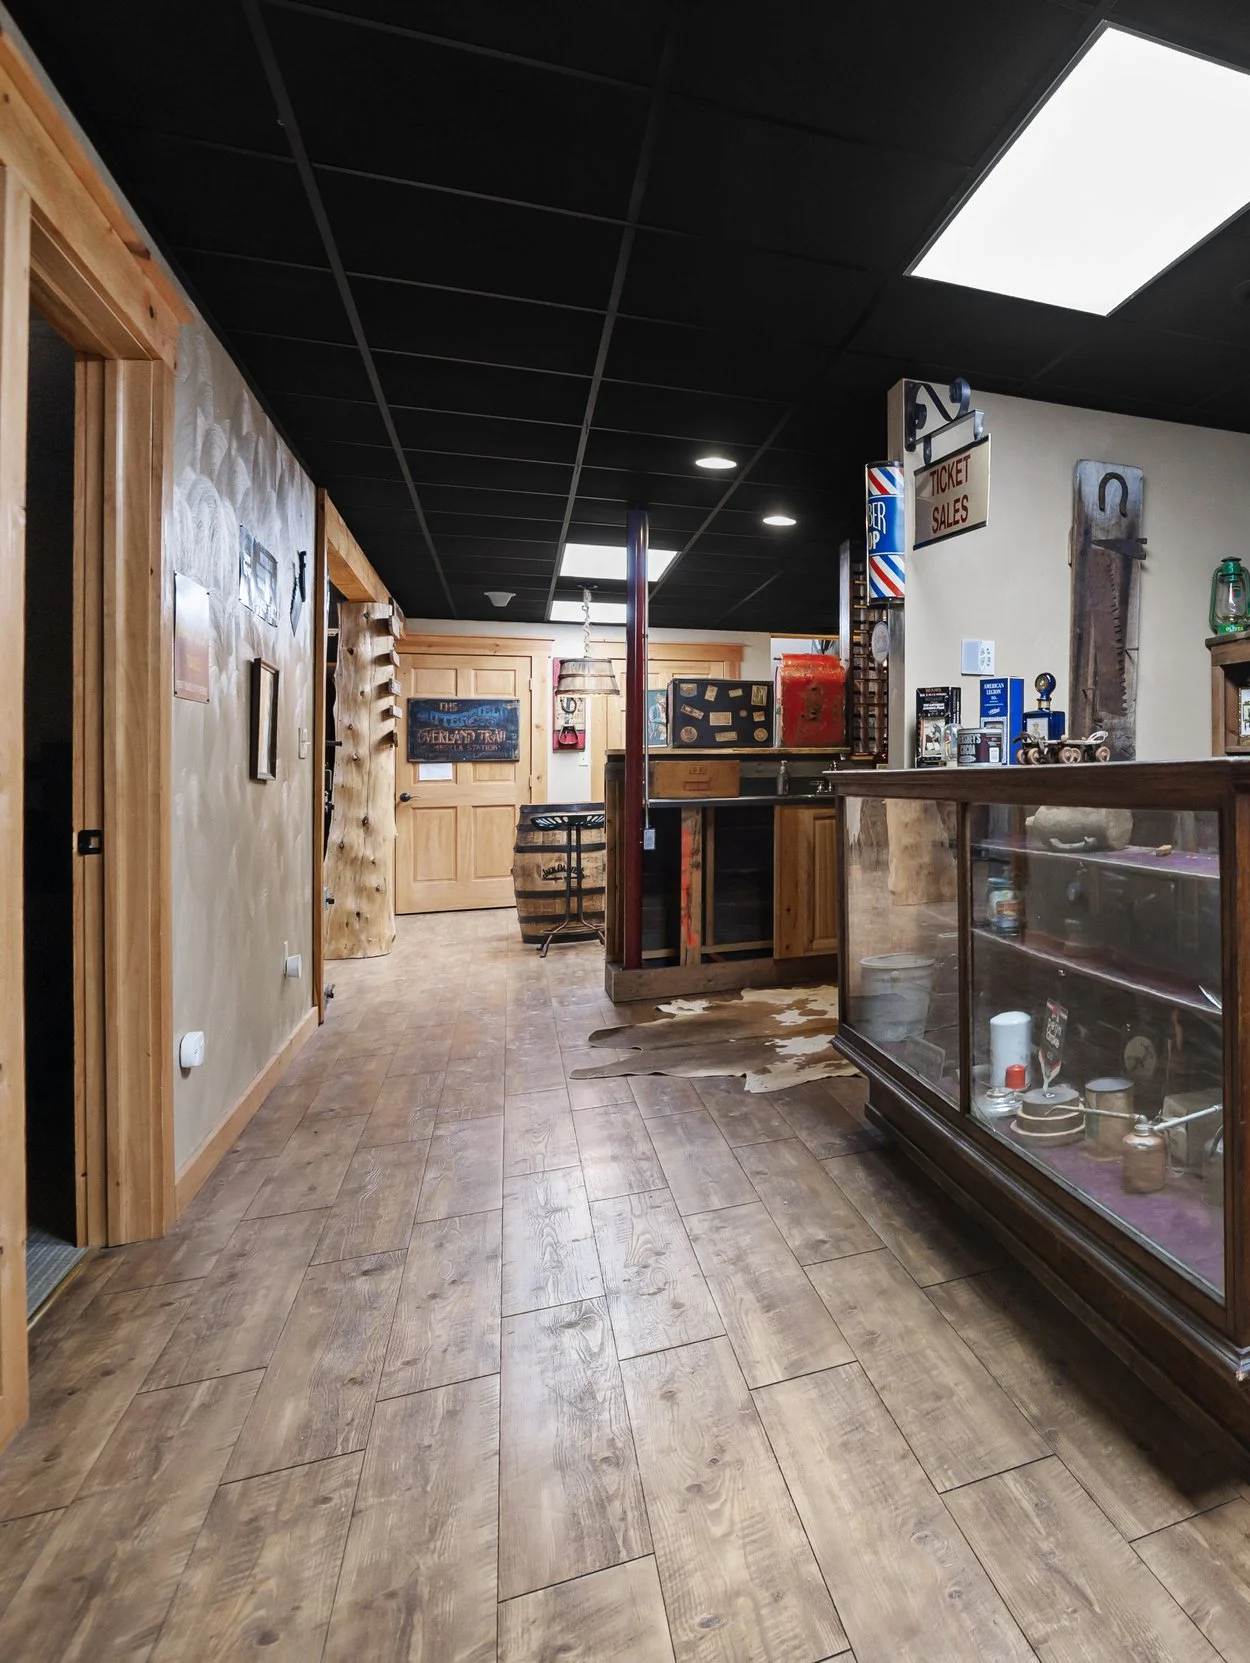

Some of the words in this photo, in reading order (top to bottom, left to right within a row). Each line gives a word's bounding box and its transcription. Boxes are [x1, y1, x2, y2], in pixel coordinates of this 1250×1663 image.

[929, 454, 971, 496] TICKET
[932, 494, 969, 534] SALES
[984, 682, 1005, 690] AMERICAN
[440, 702, 458, 712] THE
